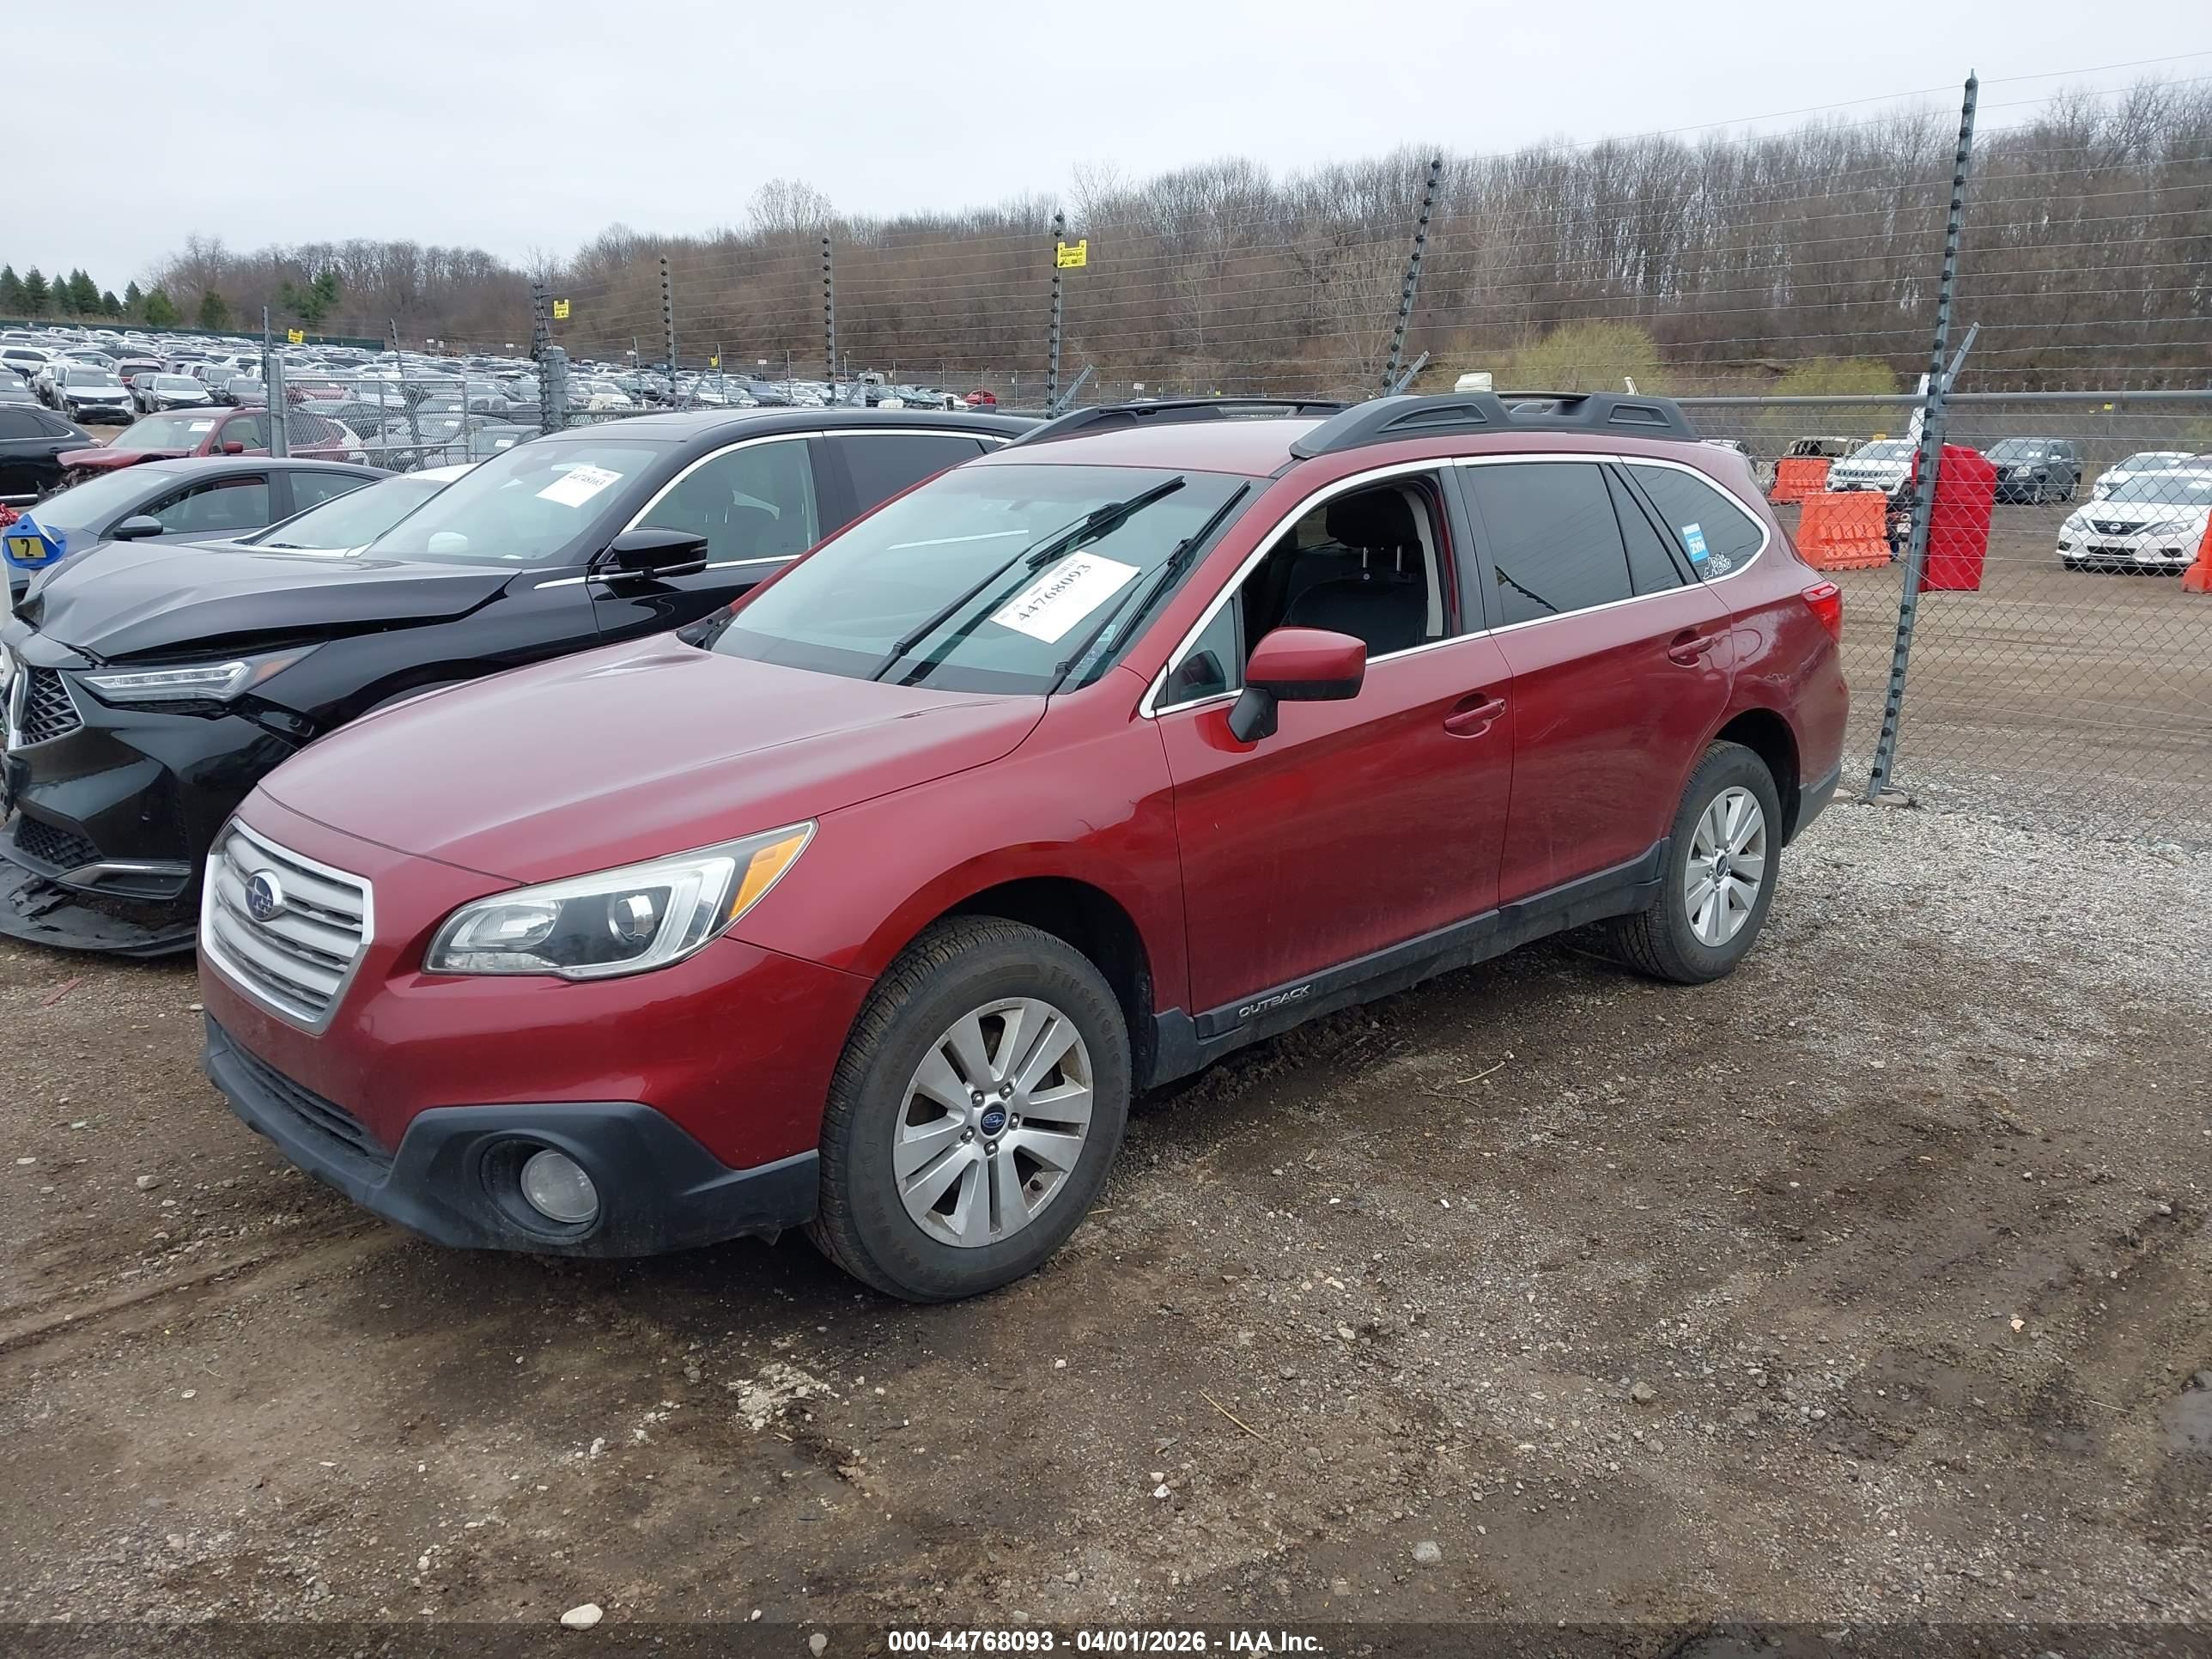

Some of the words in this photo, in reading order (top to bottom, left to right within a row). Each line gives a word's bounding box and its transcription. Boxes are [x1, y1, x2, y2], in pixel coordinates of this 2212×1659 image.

[20, 538, 34, 556] 2
[1018, 564, 1091, 622] 44768093
[1238, 984, 1311, 1018] OUTBACK
